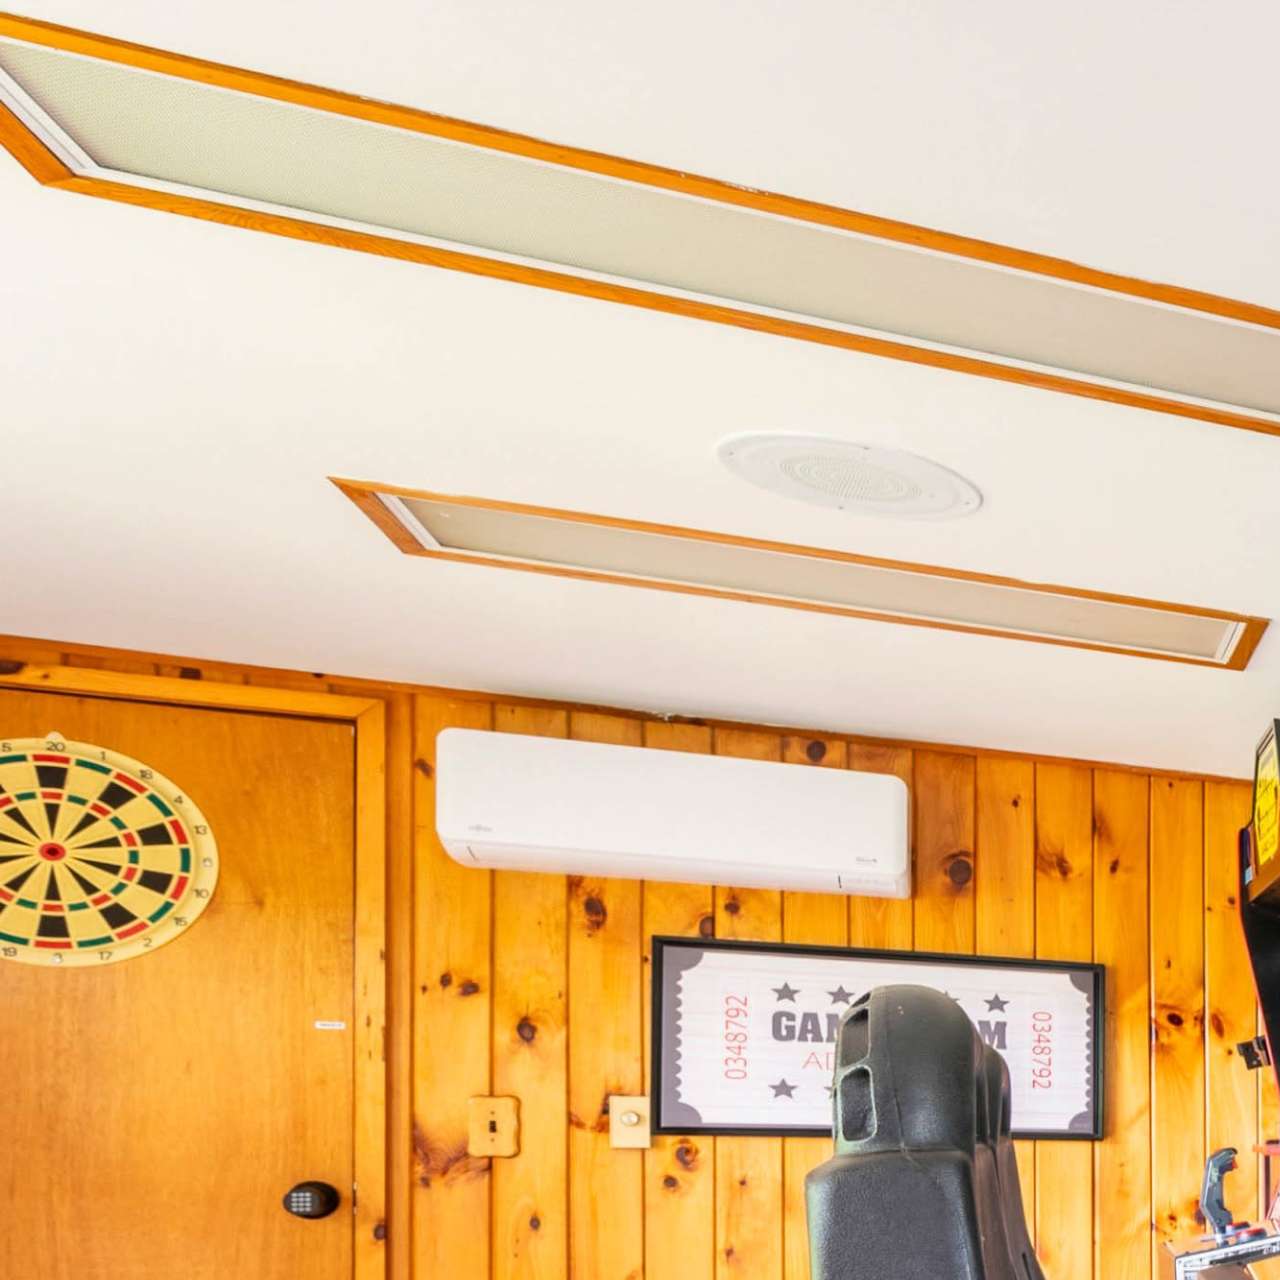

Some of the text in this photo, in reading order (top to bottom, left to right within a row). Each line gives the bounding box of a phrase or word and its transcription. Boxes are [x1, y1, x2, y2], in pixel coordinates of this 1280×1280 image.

[45, 741, 66, 752] 20
[100, 751, 106, 761] 1
[139, 769, 153, 779] 18
[174, 795, 183, 804] 4
[194, 825, 207, 835] 13
[194, 889, 209, 899] 10
[173, 916, 187, 927] 15
[143, 938, 153, 947] 2
[1, 947, 17, 957] 19
[98, 951, 112, 961] 17
[724, 995, 748, 1079] 0348792
[1032, 1011, 1052, 1089] 0348792
